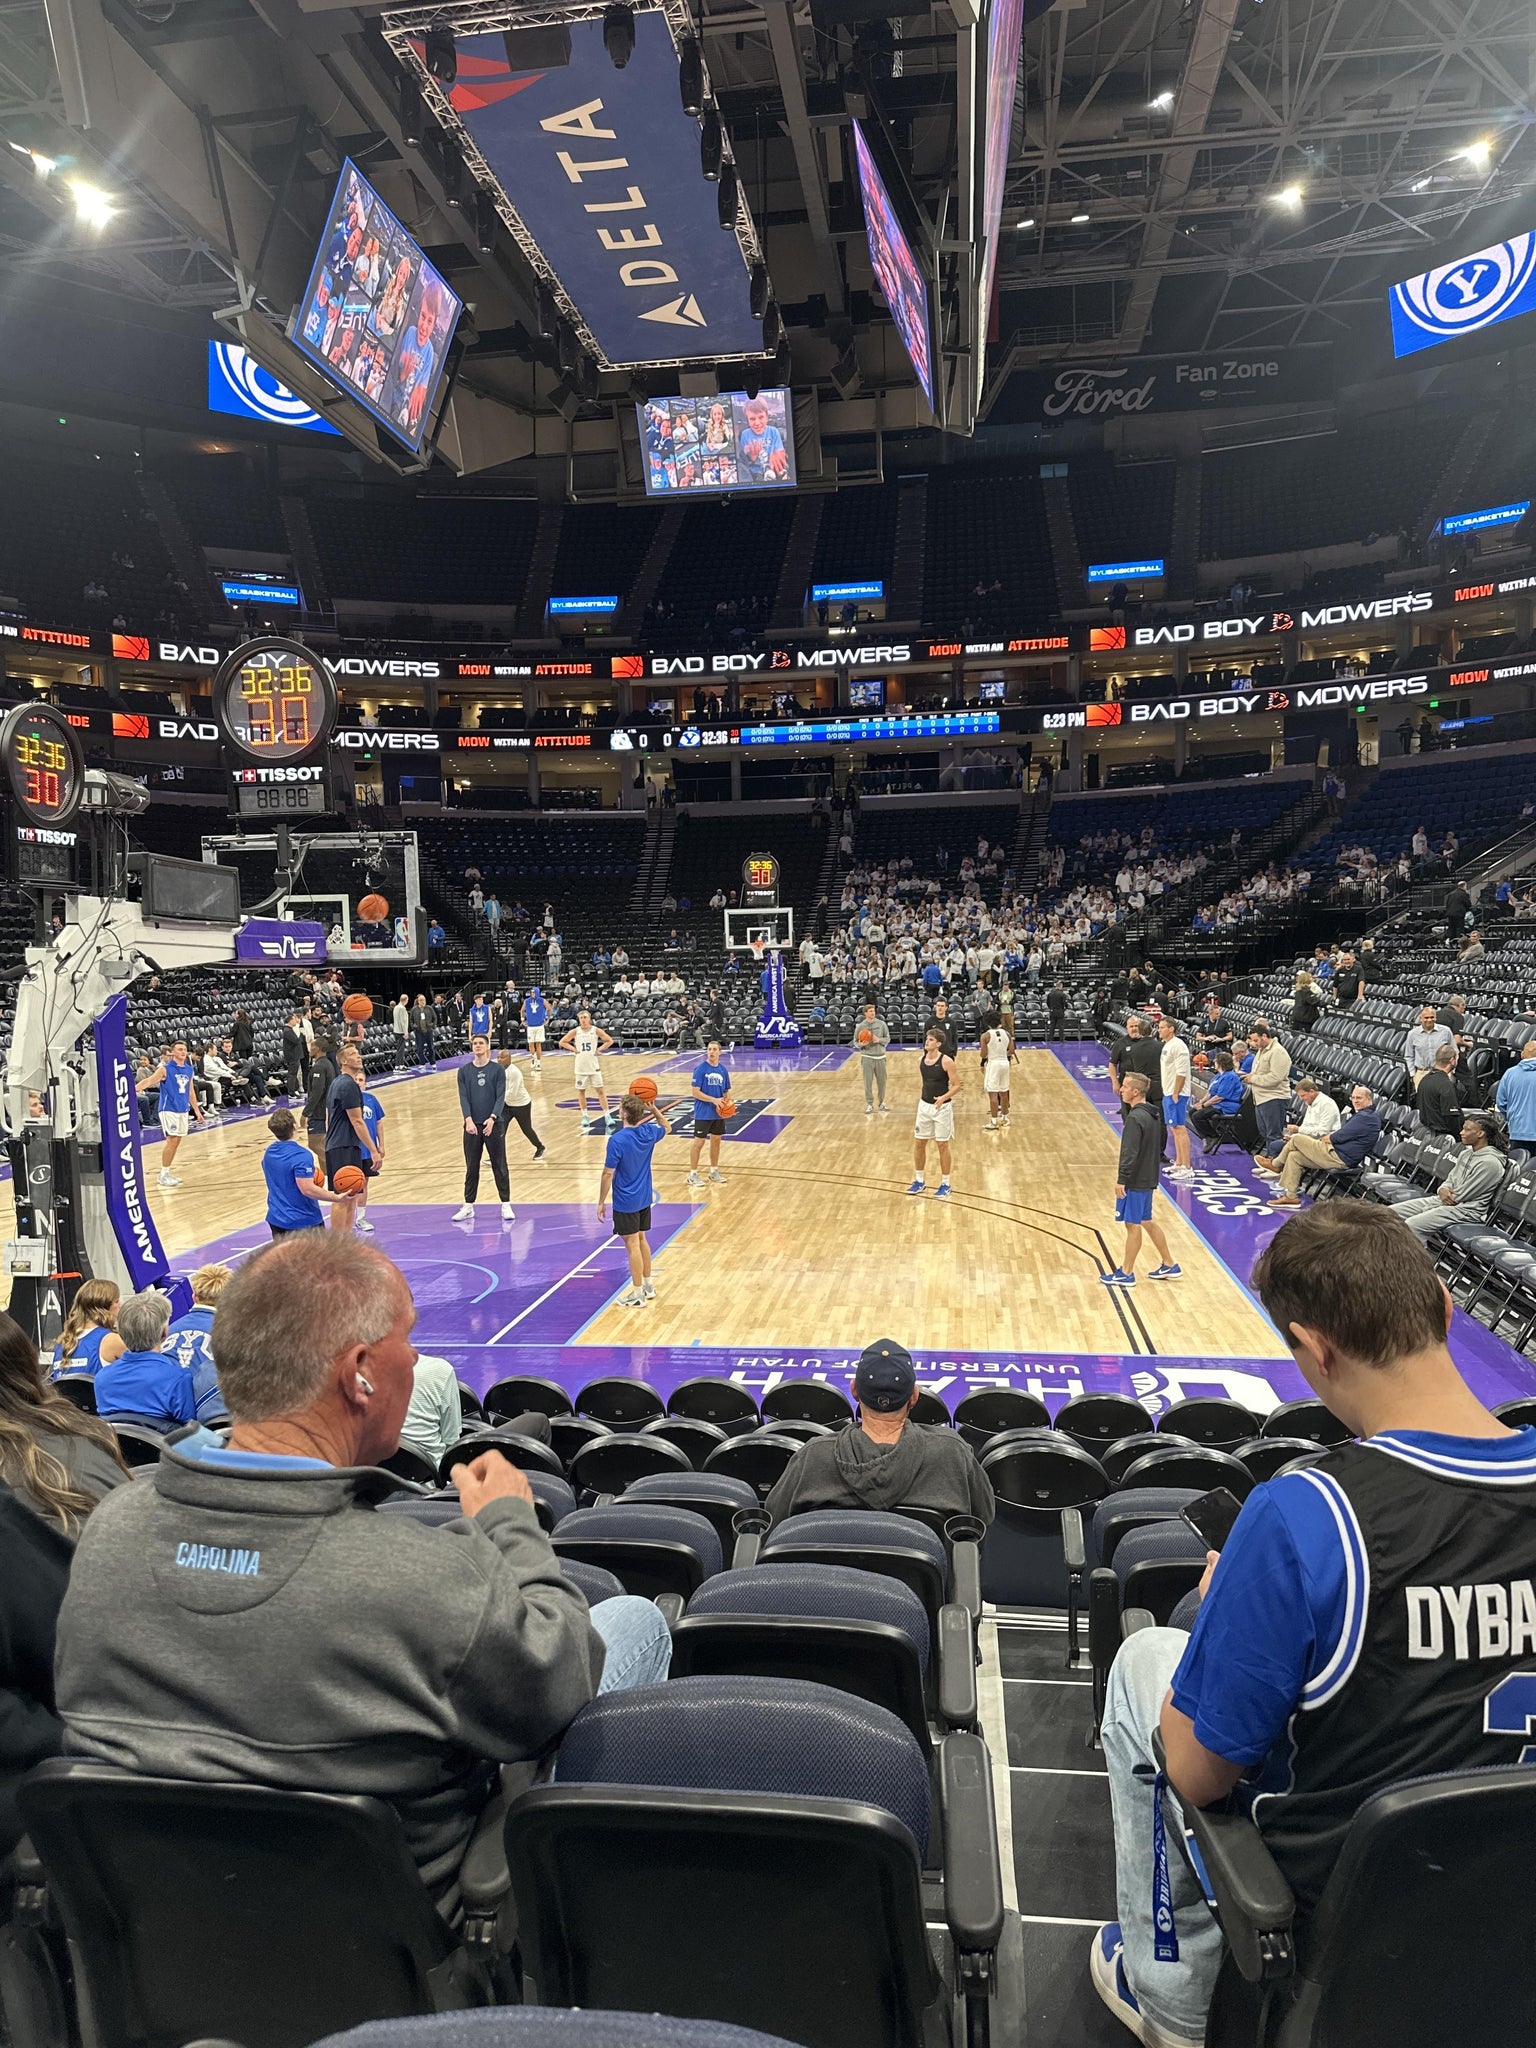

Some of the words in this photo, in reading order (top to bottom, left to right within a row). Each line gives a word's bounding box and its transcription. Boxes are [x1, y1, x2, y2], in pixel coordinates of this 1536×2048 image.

[539, 98, 679, 286] DELTA
[1175, 365, 1218, 383] Fan
[1222, 361, 1279, 380] Zone
[1043, 368, 1156, 416] Ford
[1455, 583, 1494, 601] MOW
[1498, 577, 1528, 592] WITH
[22, 627, 90, 647] ATTITUDE
[1135, 625, 1195, 645] BAD
[1204, 616, 1265, 638] BOY
[929, 644, 962, 656] MOW
[966, 644, 990, 653] WITH
[990, 643, 1004, 651] AN
[1008, 637, 1069, 651] ATTITUDE
[159, 643, 220, 664] BAD
[323, 657, 440, 677] MOWERS
[458, 664, 491, 675] MOW
[494, 667, 518, 675] WITH
[518, 666, 531, 675] AN
[535, 663, 592, 675] ATTITUDE
[652, 657, 704, 674] BAD
[712, 653, 765, 671] BOY
[797, 645, 910, 667] MOWERS
[241, 667, 312, 694] 32:36
[1450, 670, 1489, 685] MOW
[1493, 665, 1523, 679] WITH
[1131, 704, 1190, 721] BAD
[1200, 695, 1260, 716] BOY
[1297, 676, 1428, 707] MOWERS
[159, 720, 219, 740] BAD
[248, 696, 309, 746] 30
[1043, 714, 1066, 728] 6:23
[1067, 712, 1085, 727] PM
[458, 736, 490, 747] MOW
[494, 738, 518, 746] WITH
[518, 738, 531, 746] AN
[535, 735, 591, 746] ATTITUDE
[639, 734, 648, 747] 0
[663, 733, 672, 747] 0
[702, 730, 728, 745] 32:36
[731, 729, 739, 737] 30
[15, 734, 66, 771] 32:36
[257, 767, 323, 782] TISSOT
[22, 768, 59, 807] 30
[36, 829, 77, 846] TISSOT
[749, 861, 773, 870] 32:36
[751, 870, 770, 885] 30
[582, 1043, 591, 1051] 15
[114, 1058, 132, 1139] FIRST
[120, 1141, 158, 1264] AMERICA
[737, 1357, 819, 1368] UTAH
[914, 1361, 1080, 1374] UNIVERSIT
[176, 1542, 260, 1576] CAROLINA
[1405, 1580, 1536, 1660] DYBA
